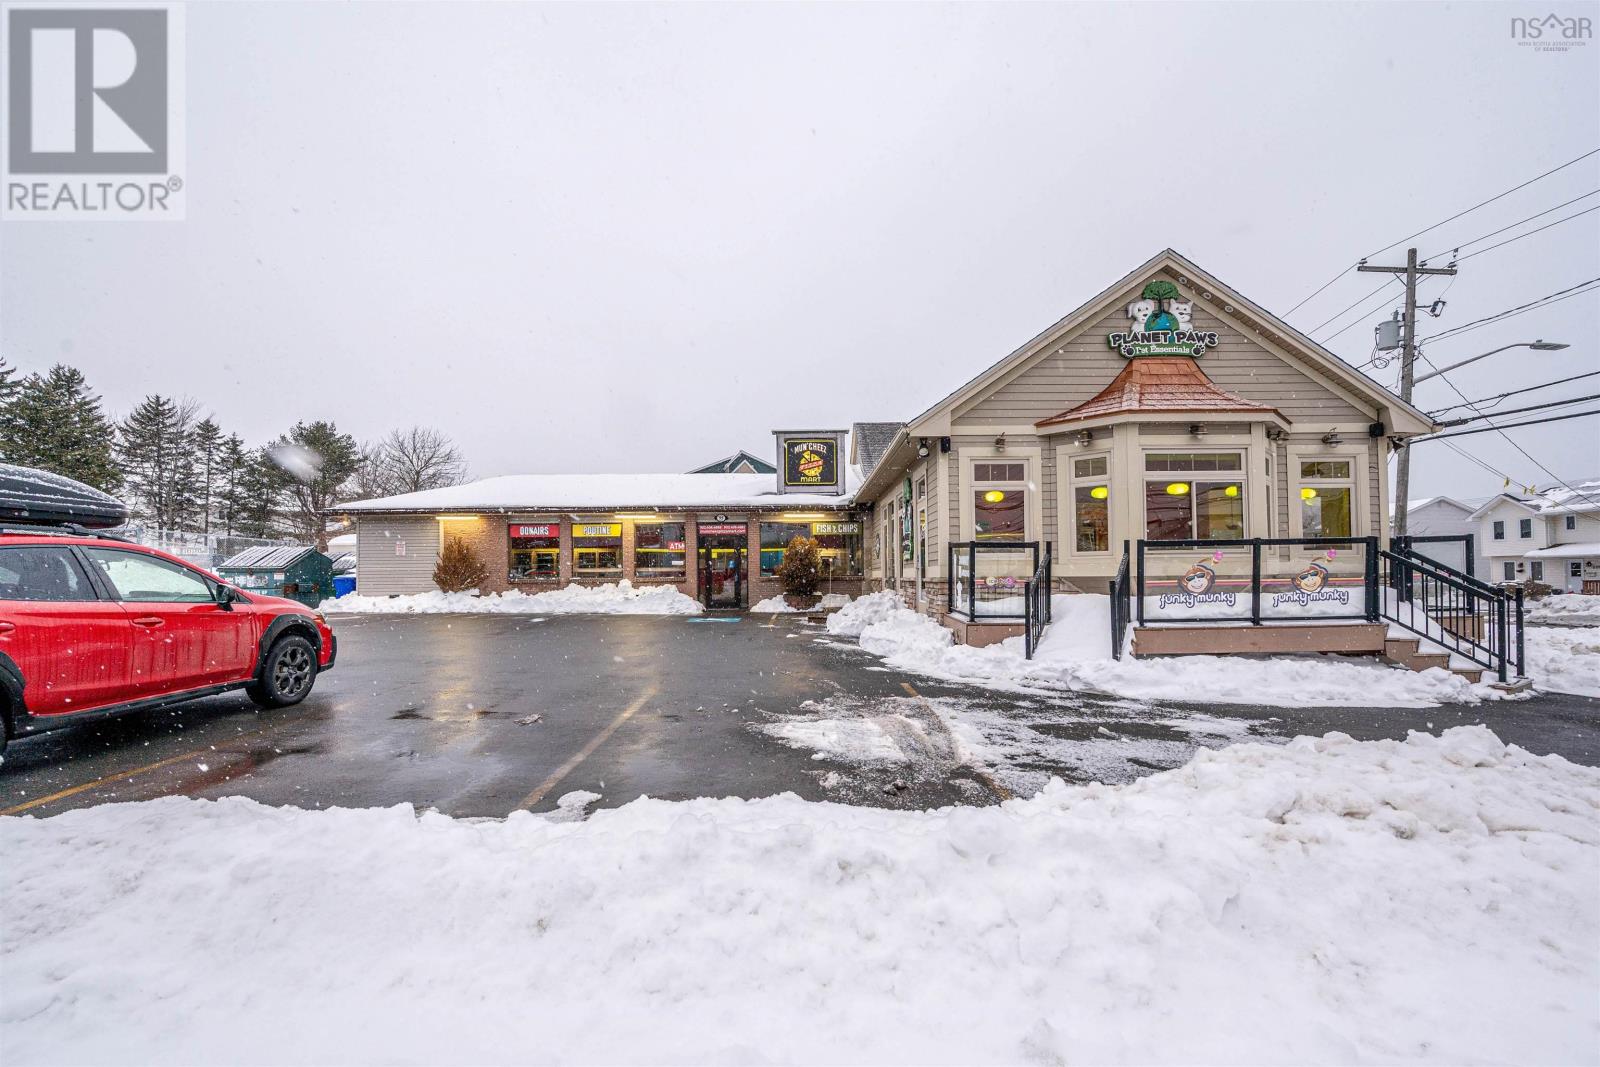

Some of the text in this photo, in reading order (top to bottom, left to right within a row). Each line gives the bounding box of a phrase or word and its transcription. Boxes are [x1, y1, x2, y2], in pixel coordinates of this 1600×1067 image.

[1110, 330, 1219, 347] PLANET PAWS
[1136, 346, 1148, 354] Pet
[583, 526, 611, 536] POUTINE
[816, 524, 832, 533] FISH
[838, 524, 858, 533] CHIPS
[1160, 592, 1235, 609] funky munky
[1310, 589, 1349, 605] munky
